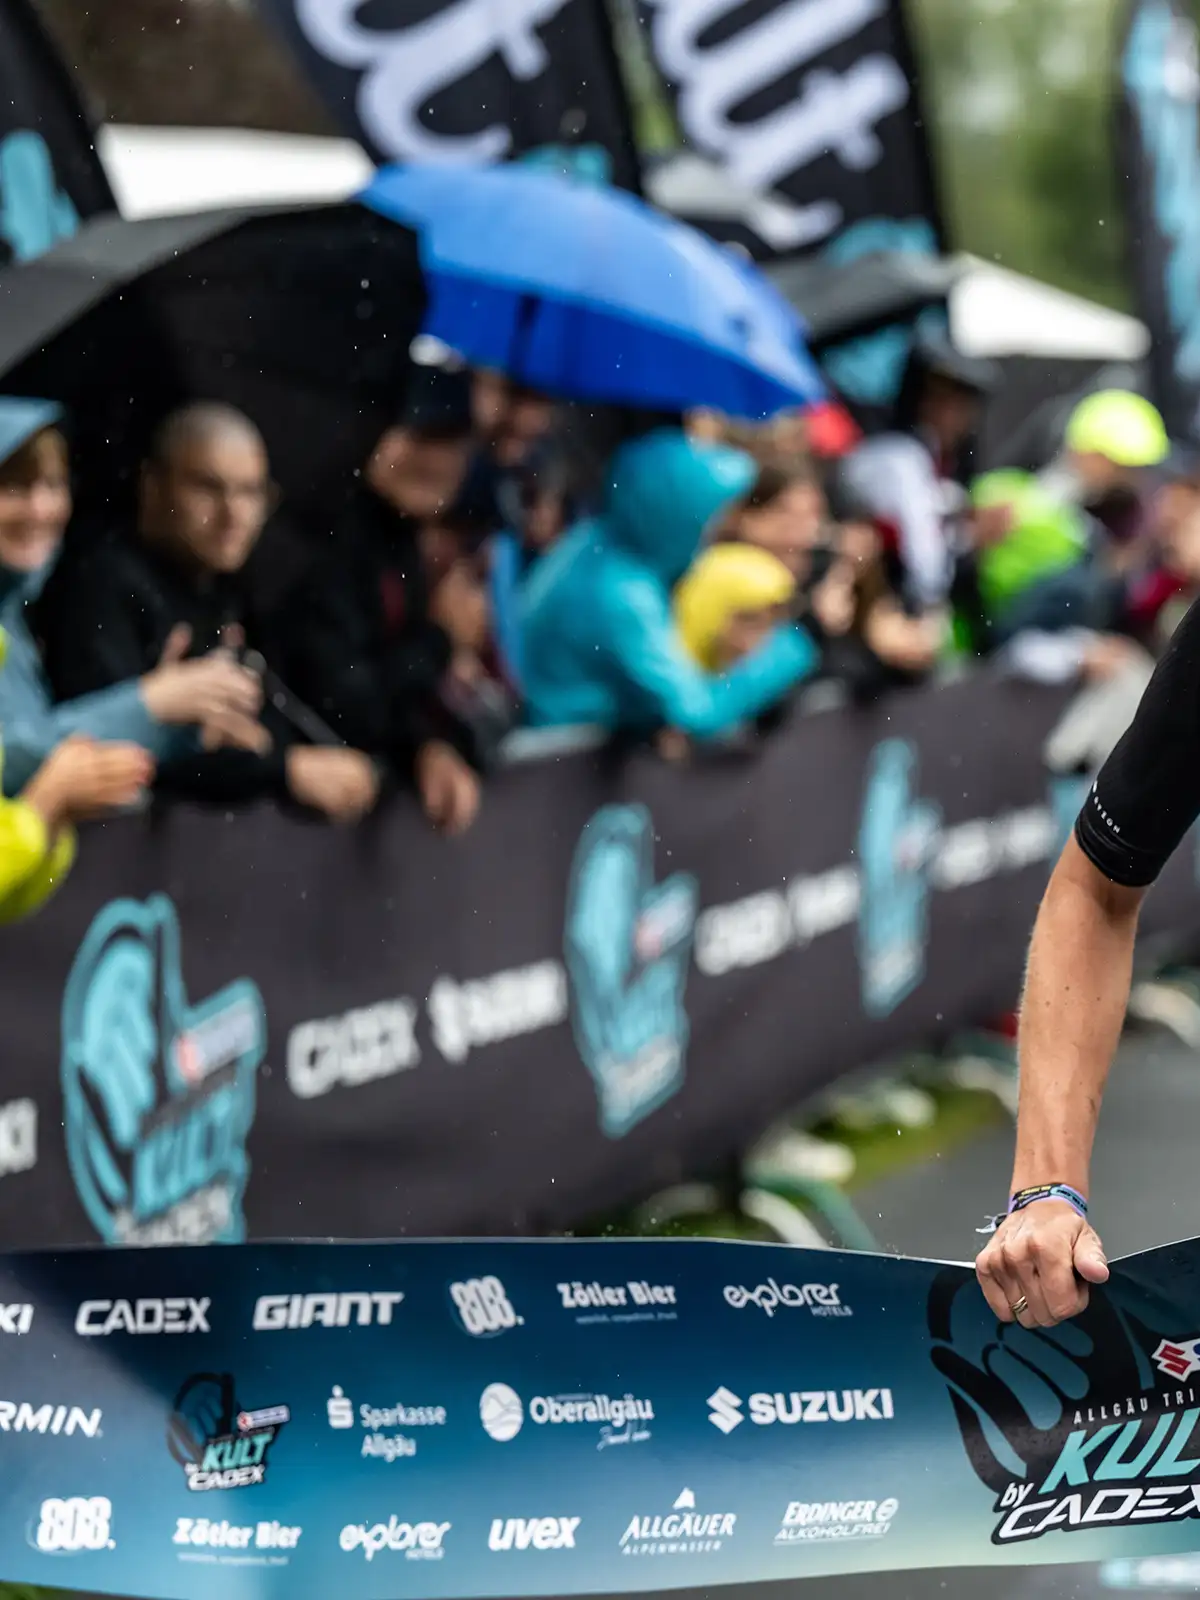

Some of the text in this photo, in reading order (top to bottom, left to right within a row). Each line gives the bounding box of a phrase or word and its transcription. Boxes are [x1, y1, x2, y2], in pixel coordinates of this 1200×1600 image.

[252, 1291, 404, 1330] GIANT
[556, 1280, 677, 1308] Zötler Bier
[723, 1277, 842, 1318] explorer
[75, 1298, 211, 1335] CADEX
[359, 1402, 447, 1432] Sparkasse
[529, 1393, 655, 1428] Oberallgäu
[748, 1388, 895, 1425] SUZUKI
[1073, 1397, 1149, 1425] ALLGÄU
[202, 1432, 273, 1472] KULT
[187, 1463, 265, 1491] CADEX
[1000, 1482, 1034, 1507] by
[618, 1511, 738, 1546] ALLGÄUER
[782, 1500, 879, 1526] ERDINGER
[172, 1517, 303, 1549] Zötler Bier
[339, 1514, 452, 1562] explorer
[488, 1516, 581, 1552] uvex
[773, 1522, 893, 1542] ALKOHOLFREI
